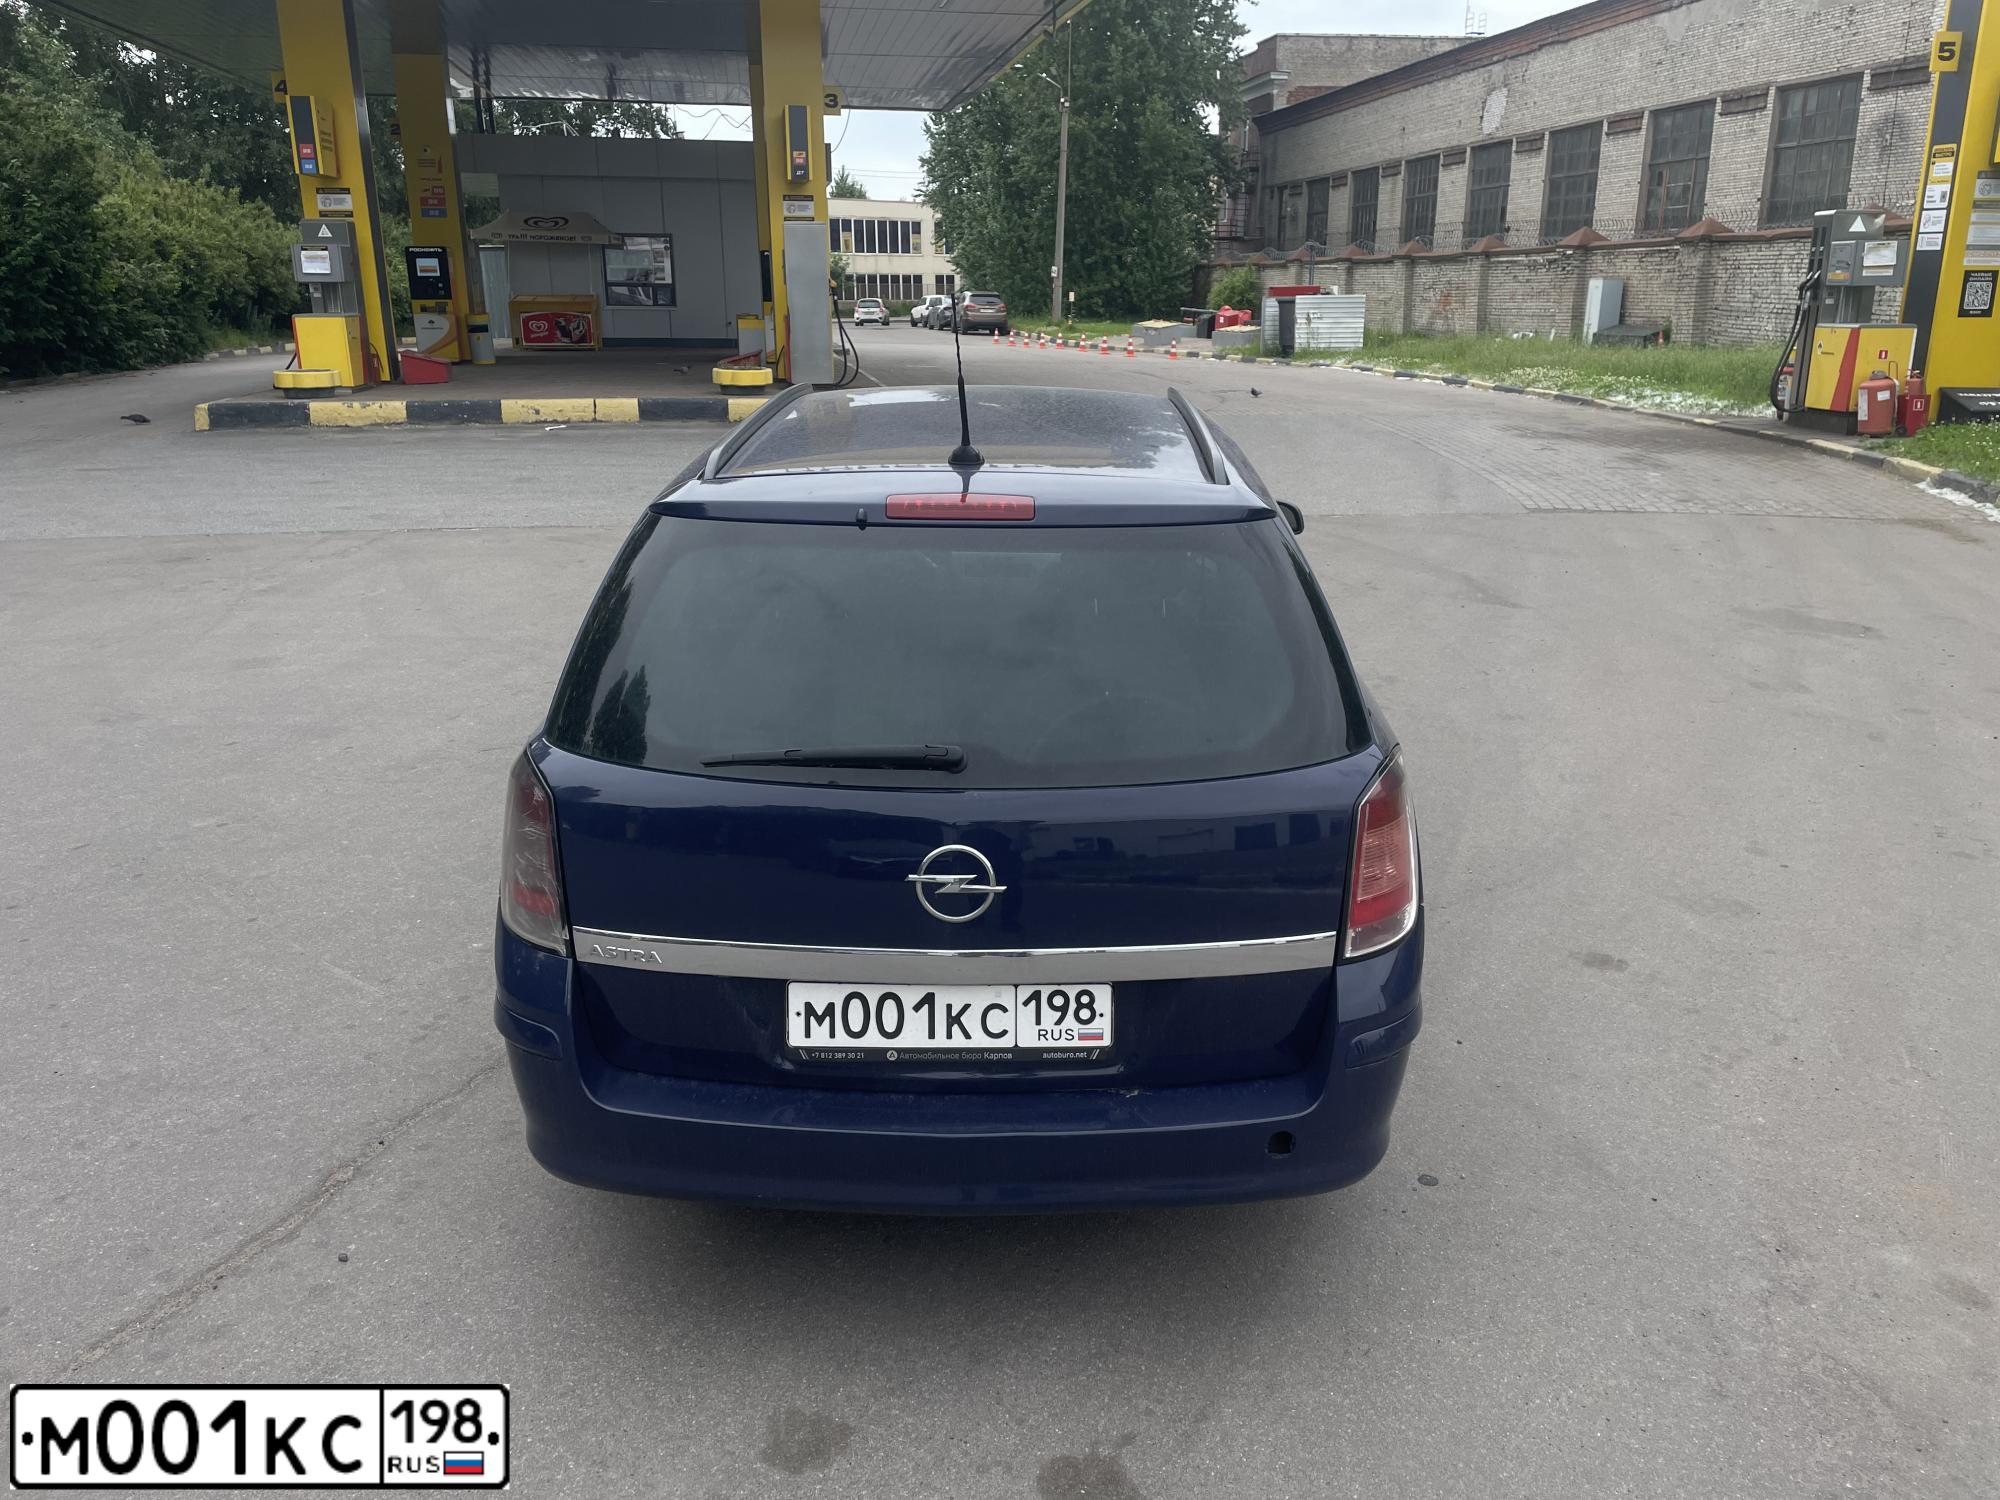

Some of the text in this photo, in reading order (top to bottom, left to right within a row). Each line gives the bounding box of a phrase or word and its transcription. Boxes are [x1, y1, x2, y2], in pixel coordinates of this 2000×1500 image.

[1937, 41, 1956, 61] 5
[274, 79, 288, 95] 4
[824, 93, 839, 108] 3
[591, 944, 663, 964] ASTRA
[1022, 989, 1097, 1026] 198
[1037, 1028, 1075, 1041] RUS
[820, 1052, 833, 1060] 812
[834, 1052, 846, 1060] 389
[847, 1052, 856, 1060] 30
[856, 1052, 865, 1060] 21
[899, 1051, 1013, 1061] Автомобильное бюро Карпов
[1042, 1051, 1088, 1060] autoburo.net
